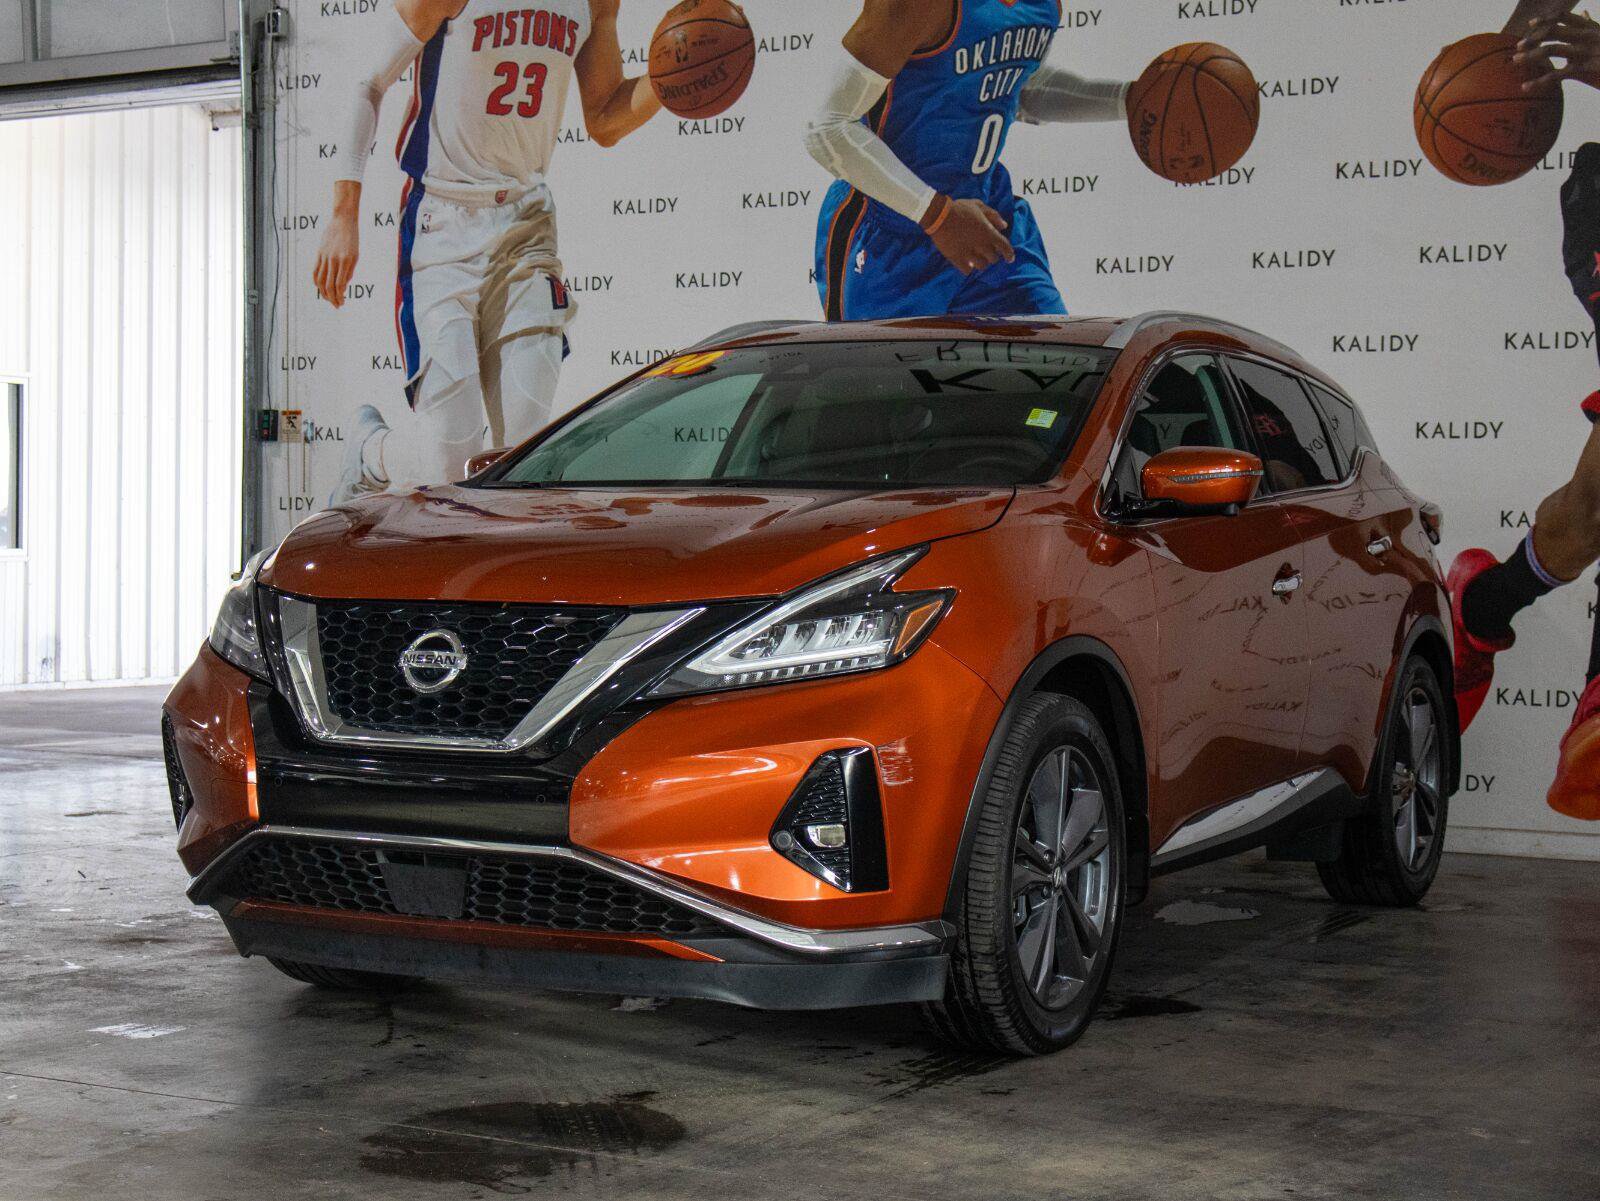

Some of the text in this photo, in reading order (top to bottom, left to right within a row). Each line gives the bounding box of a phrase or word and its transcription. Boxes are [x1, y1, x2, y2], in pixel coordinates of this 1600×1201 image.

[320, 0, 378, 16] KALIDY
[1178, 0, 1256, 18] KALIDY
[472, 9, 579, 57] PISTONS
[486, 61, 548, 118] 23
[979, 67, 1024, 103] CITY
[1258, 77, 1339, 97] KALIDY
[678, 117, 745, 135] KALIDY
[971, 114, 1004, 175] 0
[1336, 160, 1422, 179] KALIDY
[1023, 176, 1099, 194] KALIDY
[613, 198, 678, 215] KALIDY
[742, 191, 810, 209] KALIDY
[280, 216, 318, 230] LIDY
[1252, 250, 1336, 268] KALIDY
[1420, 245, 1508, 263] KALIDY
[1096, 256, 1174, 274] KALIDY
[676, 272, 742, 288] KALIDY
[1333, 335, 1418, 353] KALIDY
[1505, 331, 1596, 350] KALIDY
[674, 427, 730, 442] KALID
[1416, 422, 1504, 439] KALIDY
[403, 653, 457, 666] NISSAN
